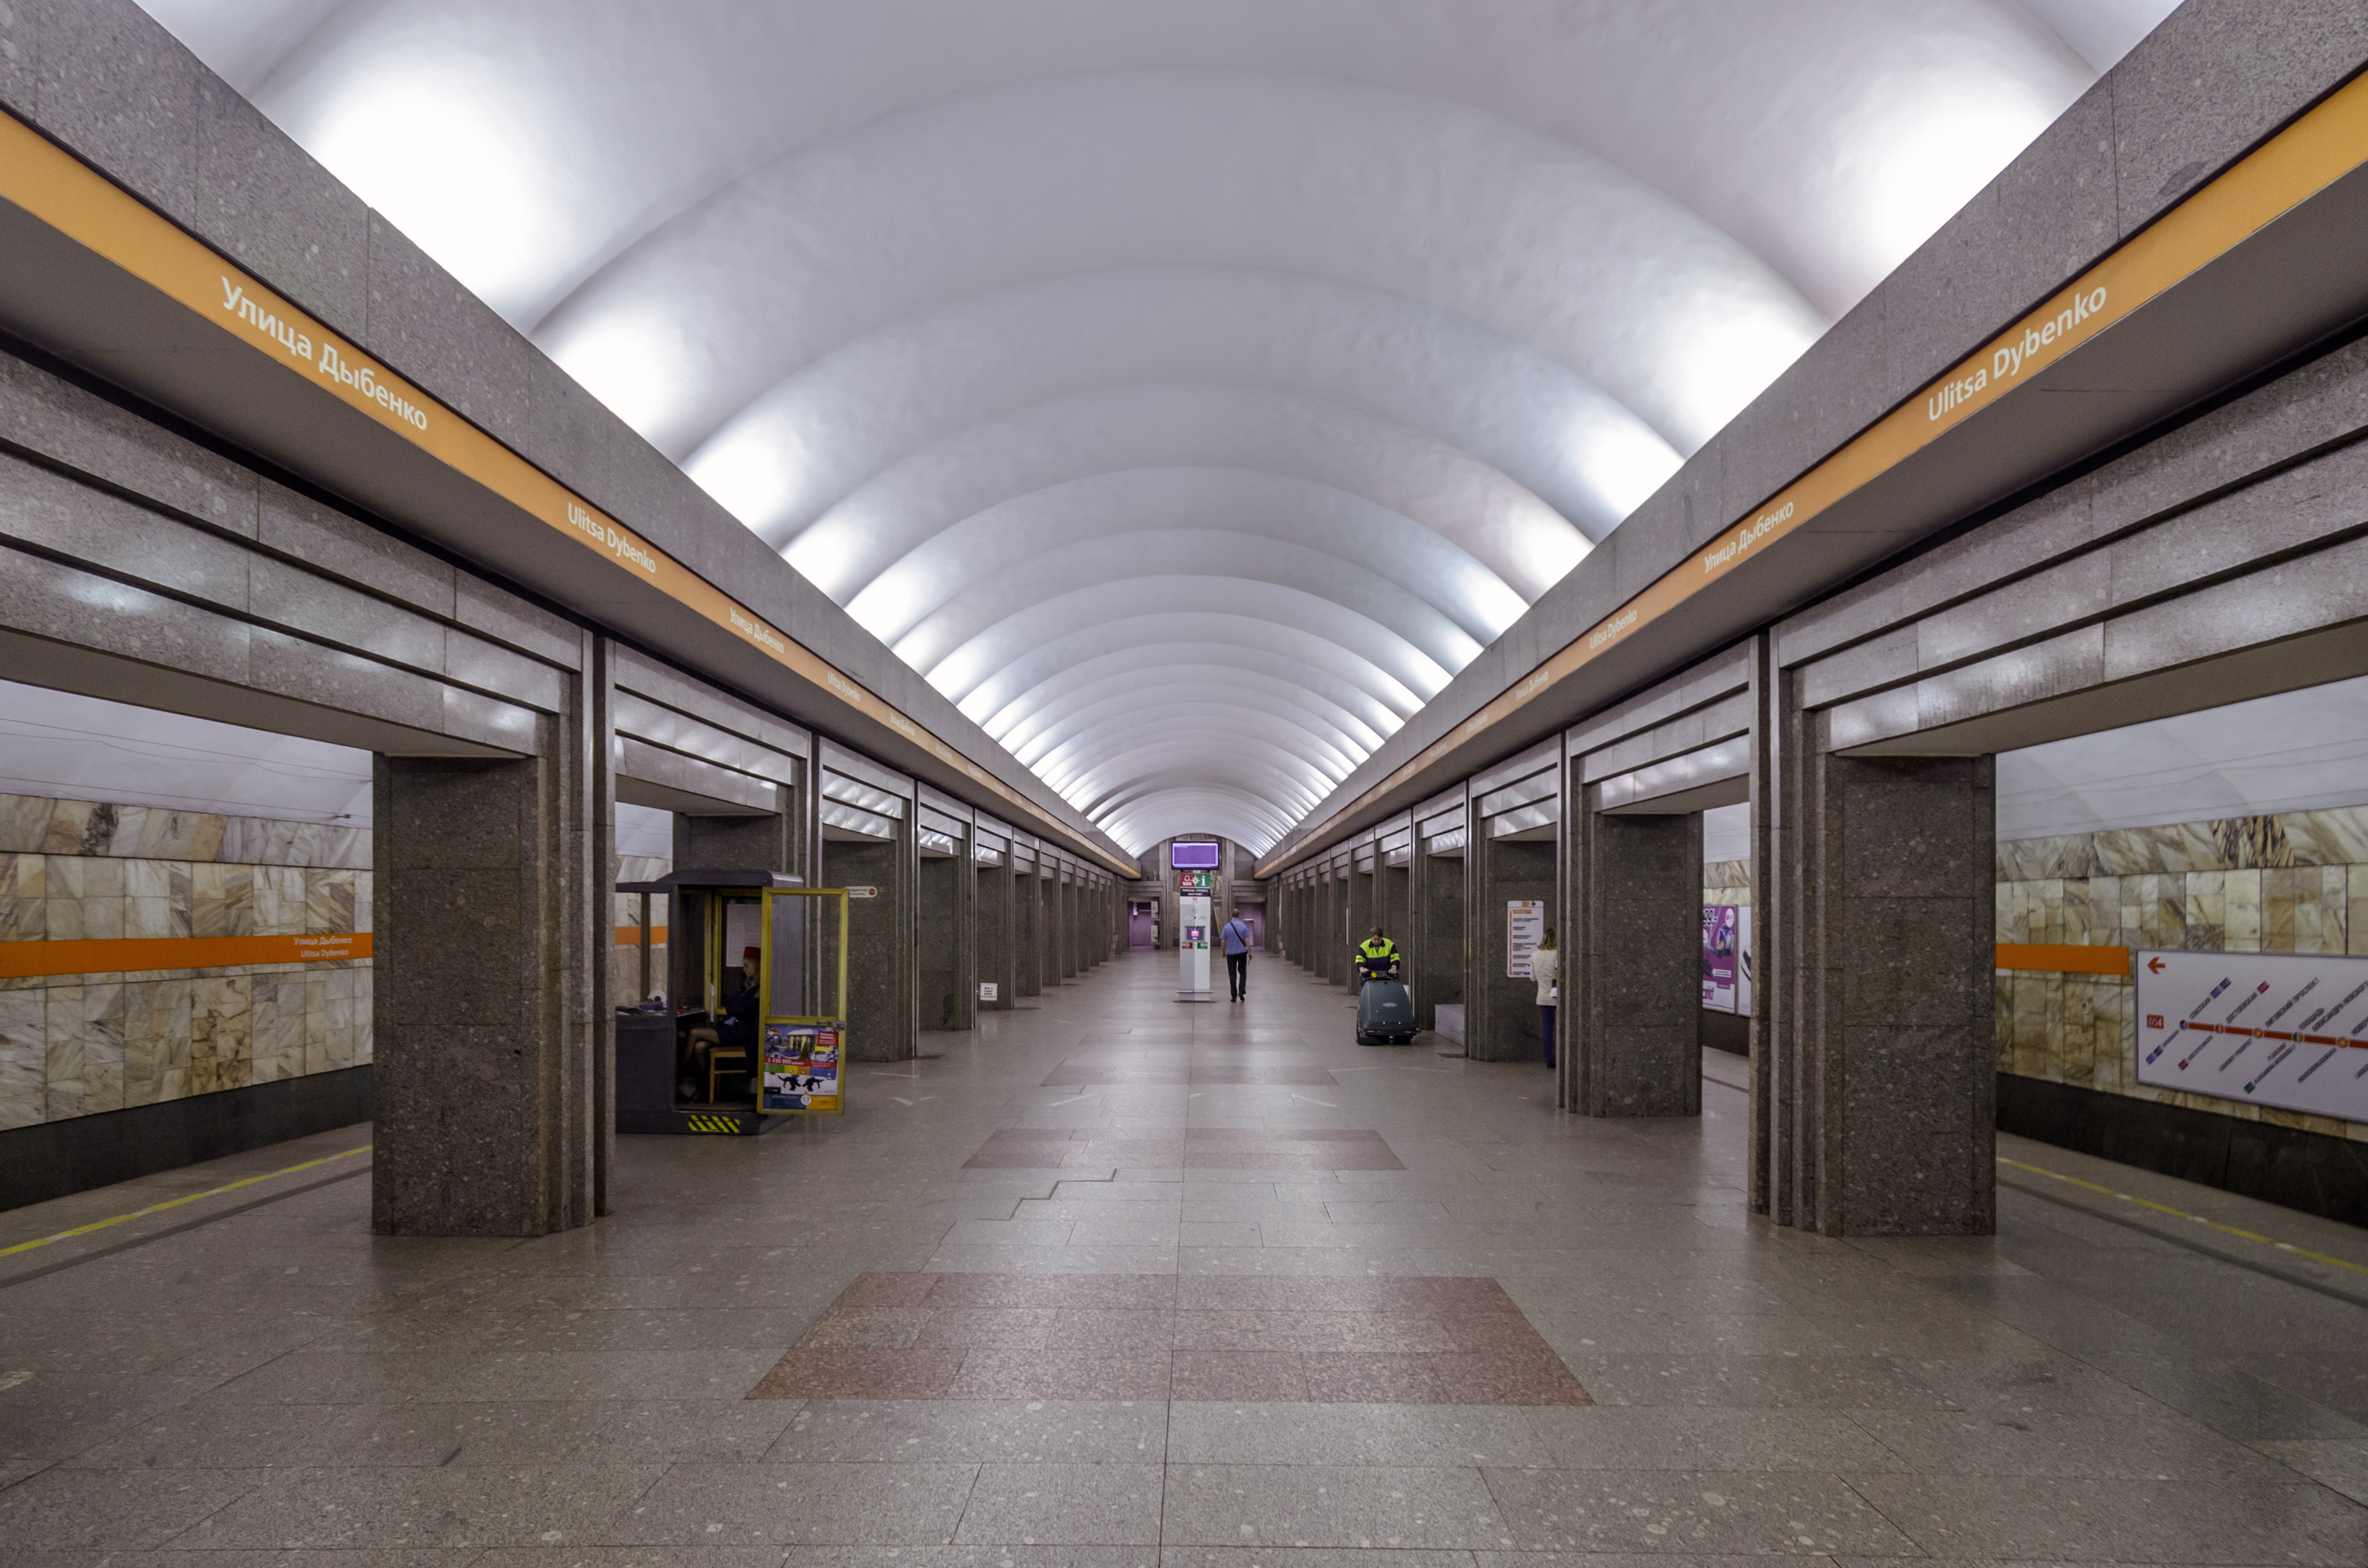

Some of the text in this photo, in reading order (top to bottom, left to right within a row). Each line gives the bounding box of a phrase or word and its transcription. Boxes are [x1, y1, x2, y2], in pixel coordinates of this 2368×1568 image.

[221, 275, 427, 430] Улица Дыбенко
[1929, 286, 2106, 421] Ulitsa Dybenko
[568, 502, 656, 573] Ulitsa Dybenko
[1704, 502, 1794, 573] Улица Дыбенко
[730, 607, 784, 654] Улица Дыбенко
[1608, 608, 1637, 639] Dybenko
[294, 935, 353, 946] Улица Дыбенко
[301, 949, 349, 958] Ulitsa Dybenko
